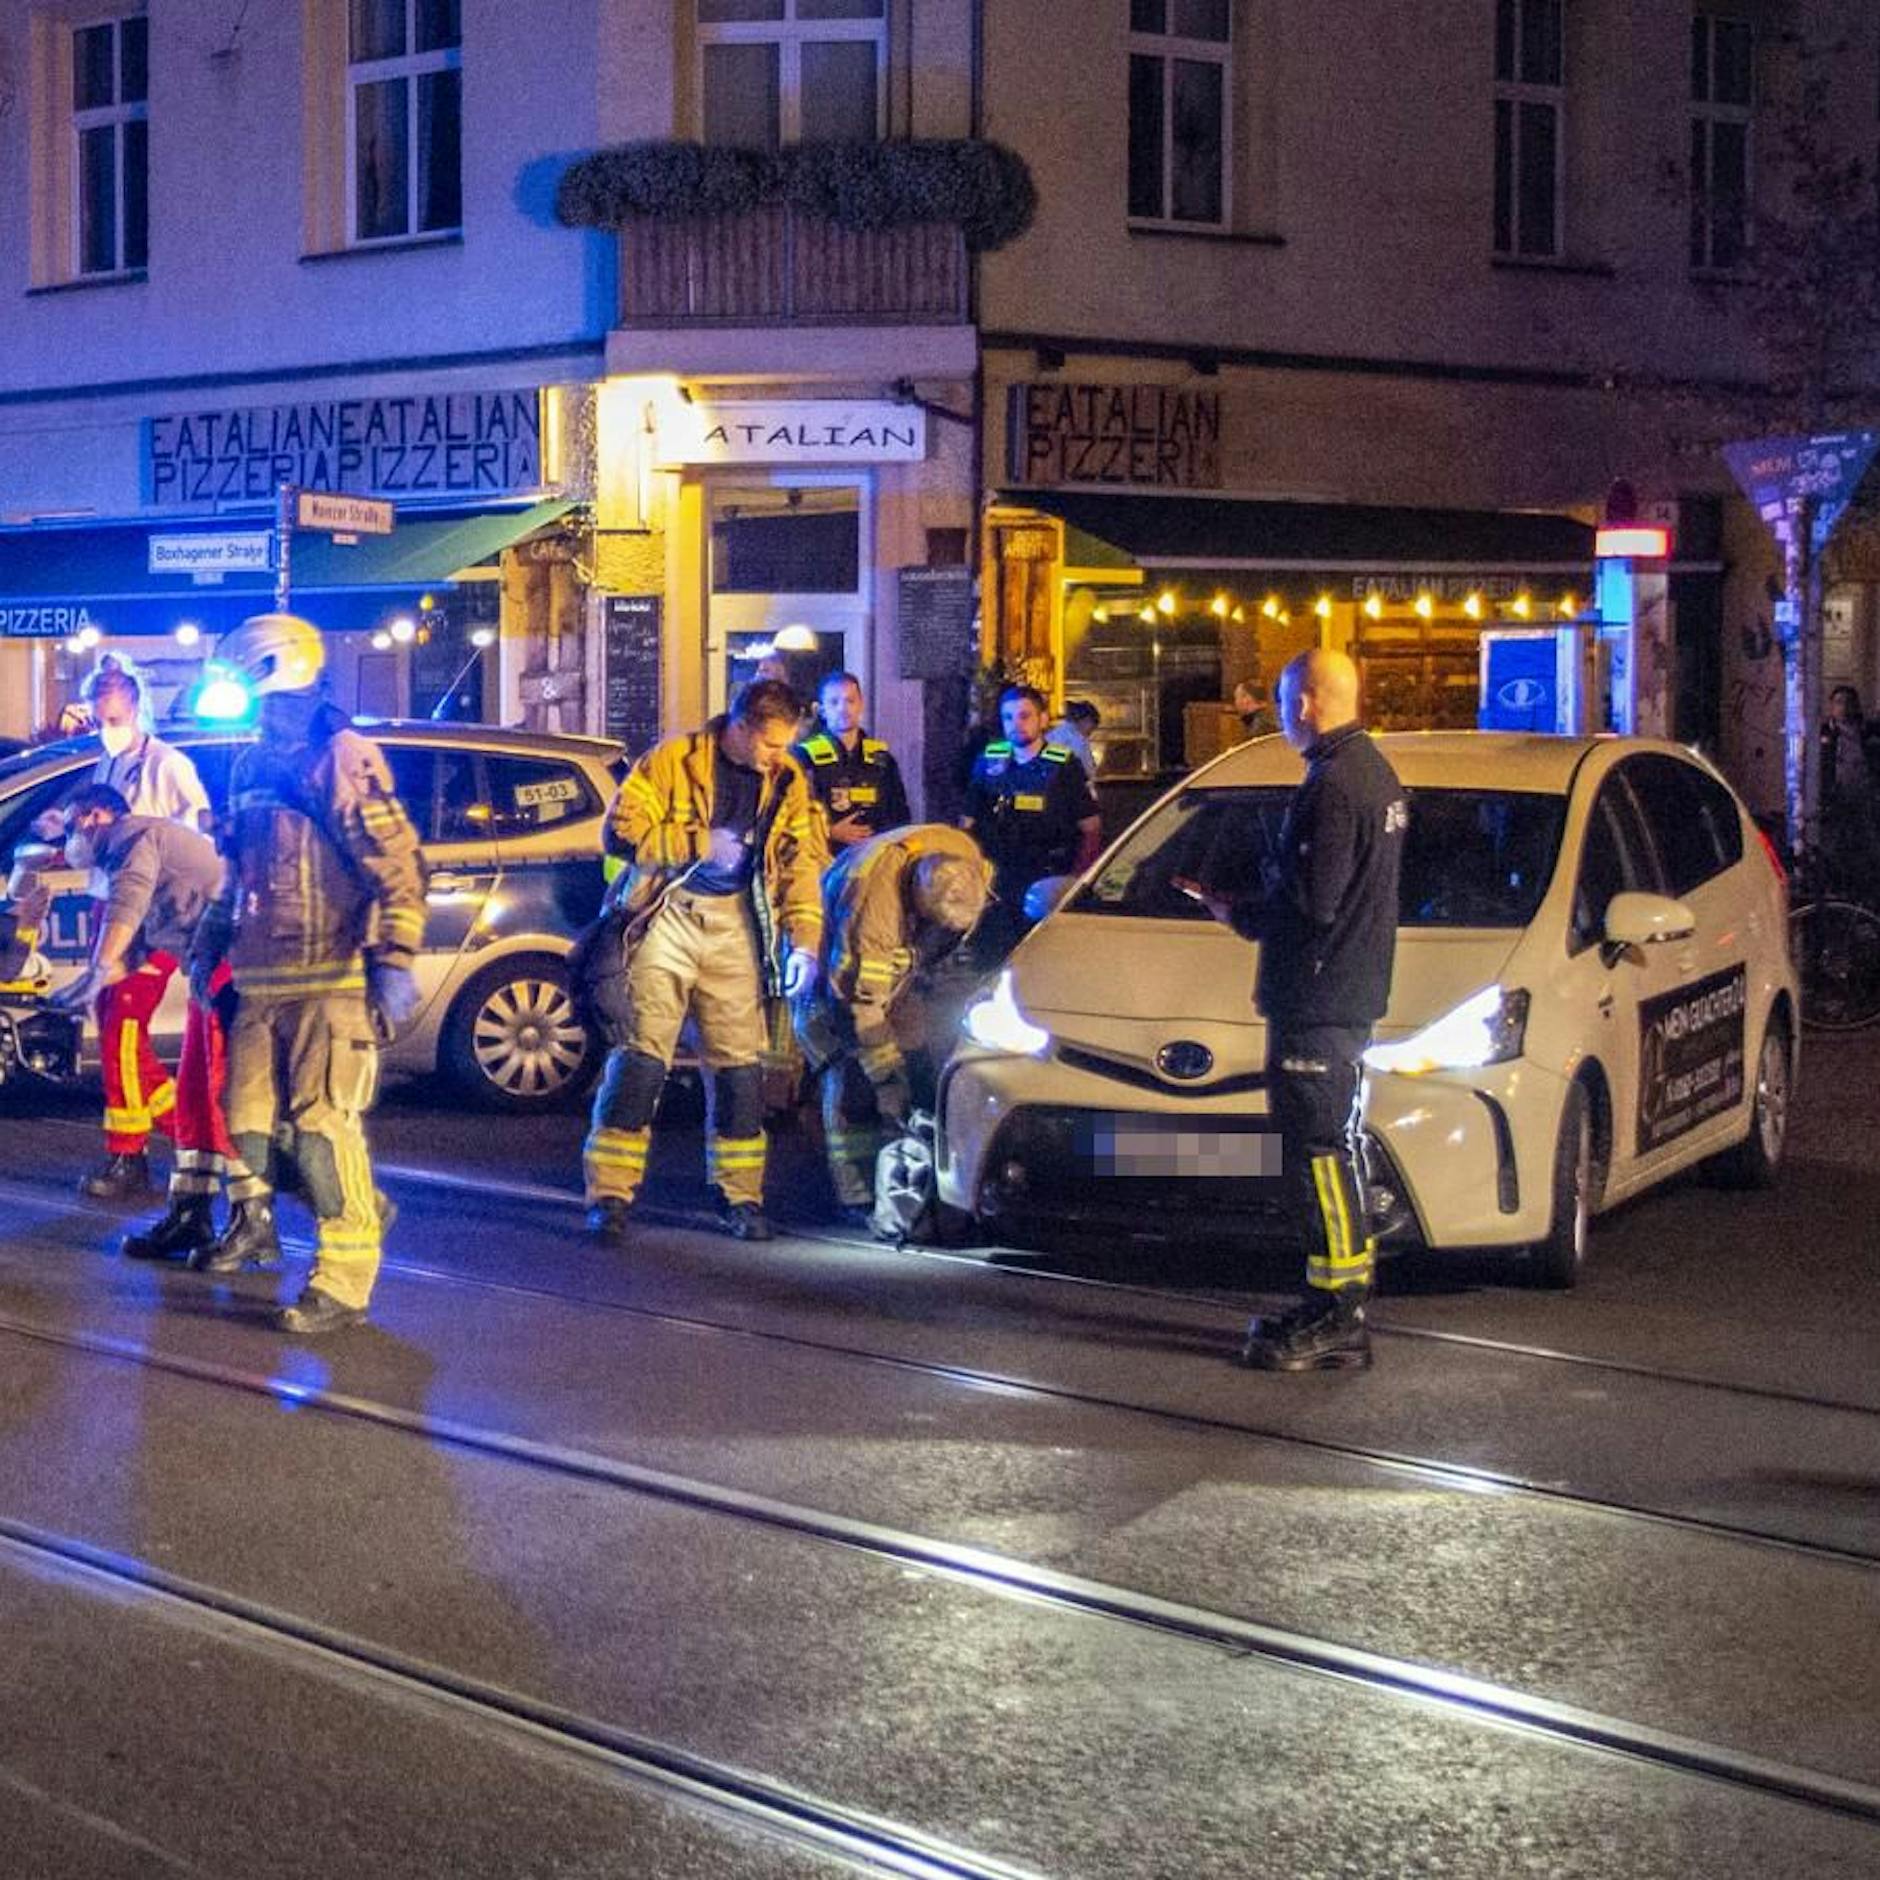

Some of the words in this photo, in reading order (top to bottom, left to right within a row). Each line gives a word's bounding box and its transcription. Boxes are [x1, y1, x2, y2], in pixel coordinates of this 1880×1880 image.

[1027, 385, 1220, 440] EATALIAN
[704, 425, 916, 447] ATALIAN
[156, 546, 223, 563] Boxhagener
[523, 783, 569, 802] 51-03
